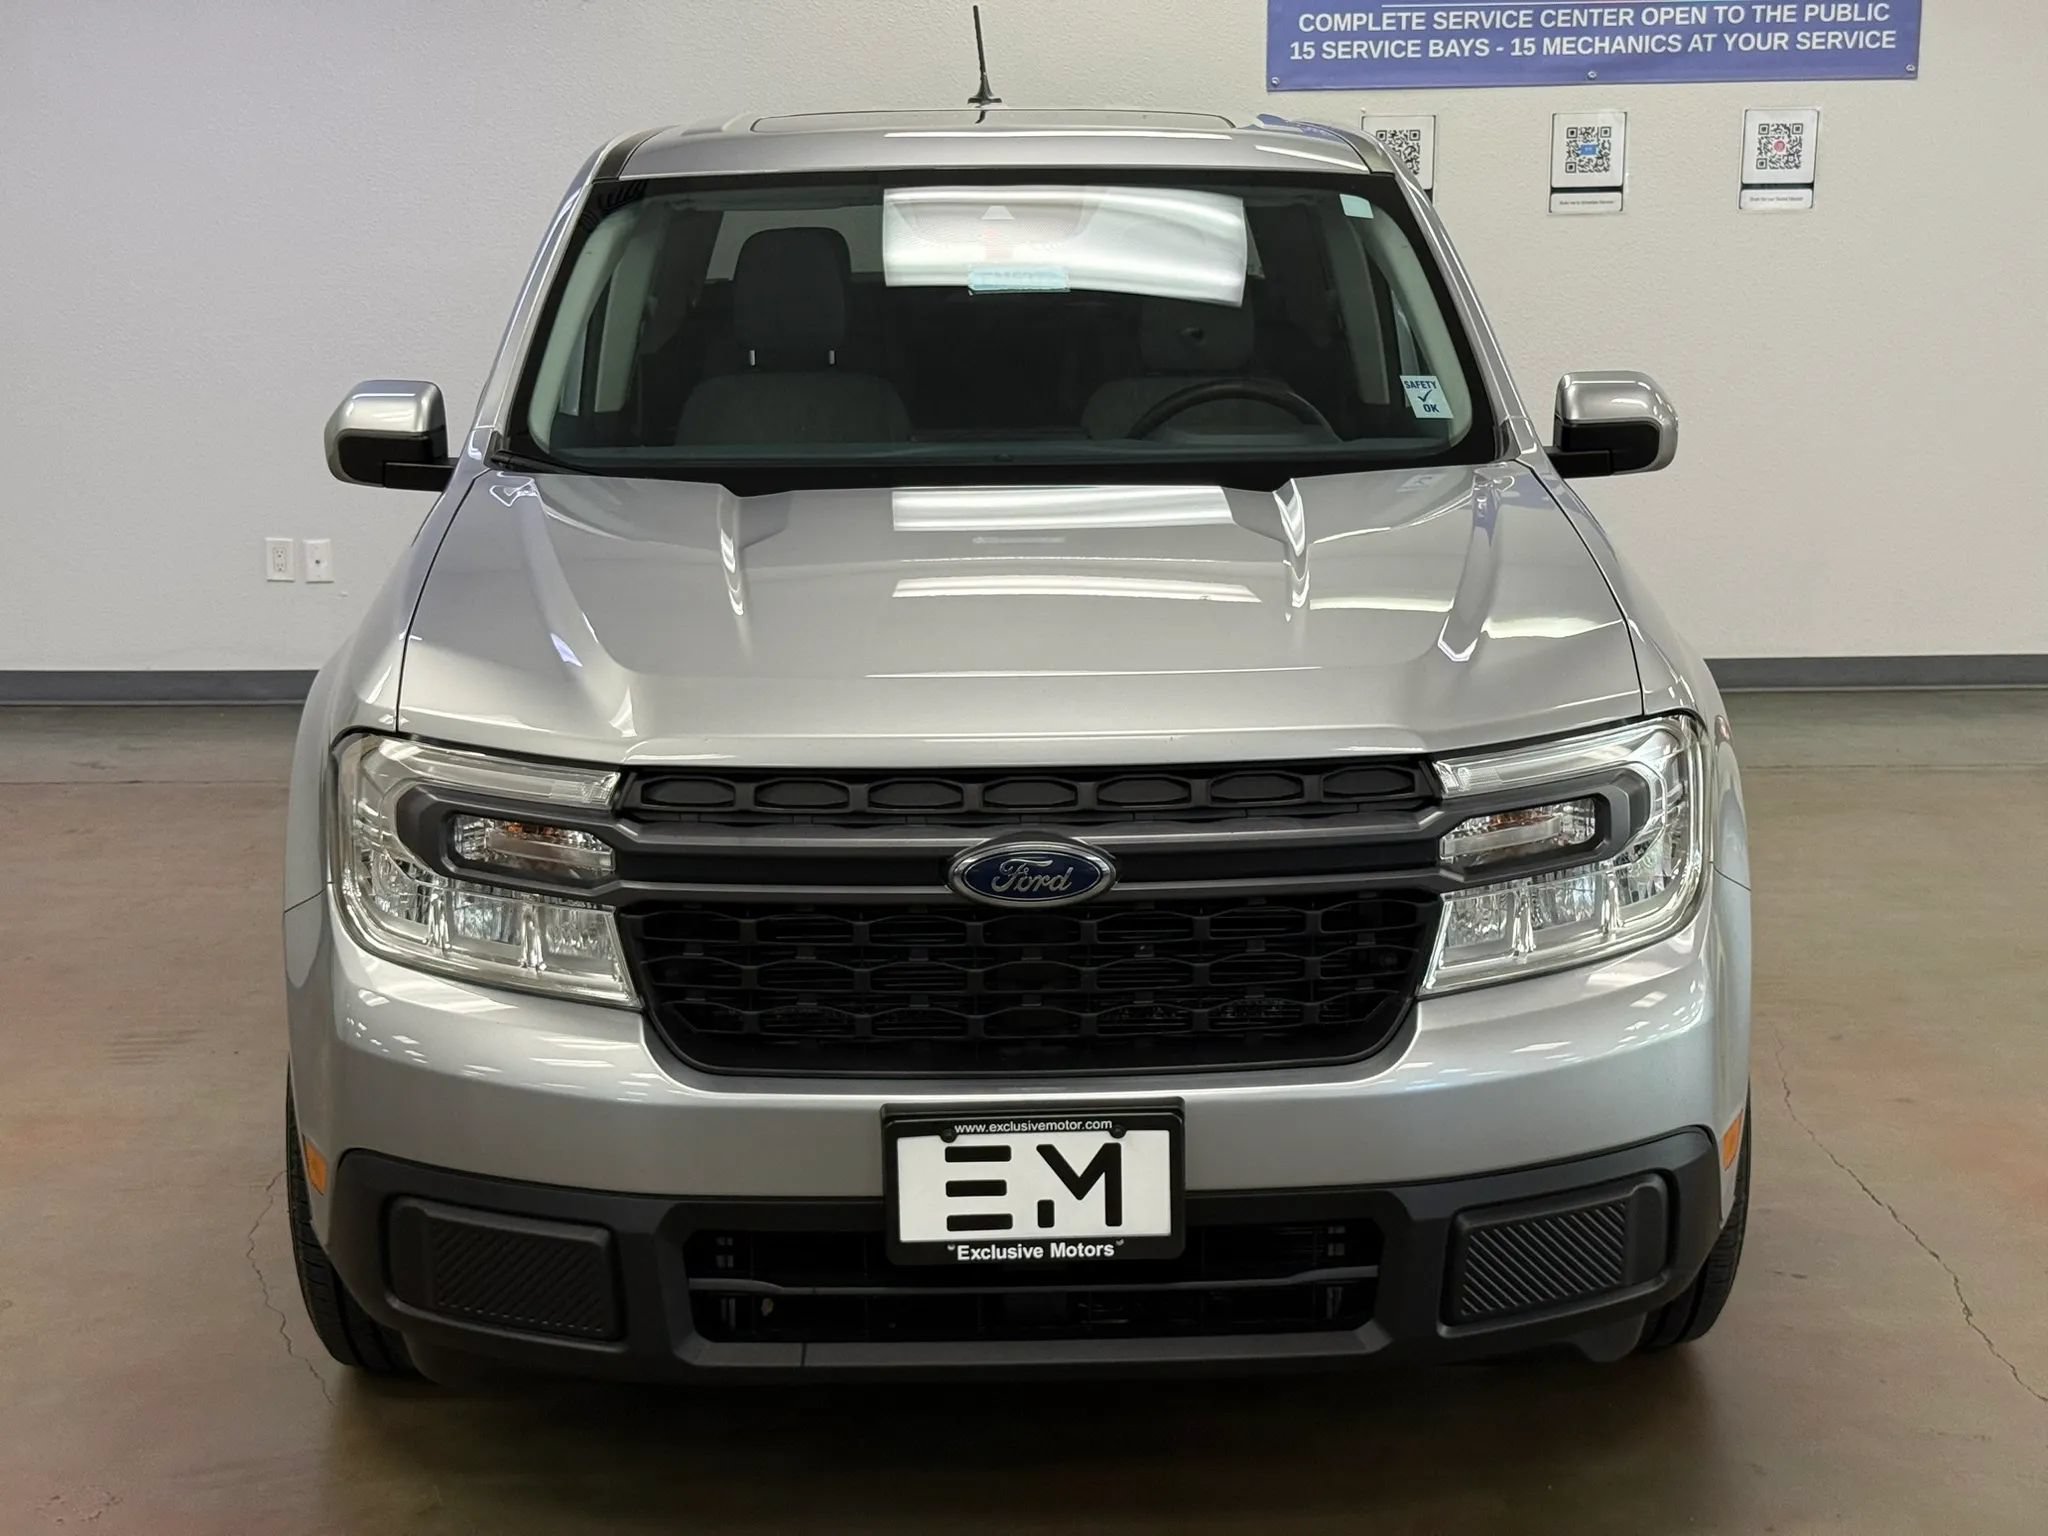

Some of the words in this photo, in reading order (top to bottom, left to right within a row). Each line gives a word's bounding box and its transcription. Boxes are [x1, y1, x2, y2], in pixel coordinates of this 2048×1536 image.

[1298, 11, 1427, 33] COMPLETE
[1432, 9, 1534, 31] SERVICE
[1539, 7, 1635, 29] CENTER
[1641, 5, 1708, 27] OPEN
[1713, 5, 1746, 25] TO
[1751, 4, 1798, 24] THE
[1803, 2, 1891, 24] PUBLIC
[1289, 41, 1316, 60] 15
[1321, 39, 1423, 60] SERVICE
[1428, 37, 1491, 58] BAYS
[1510, 37, 1536, 57] 15
[1542, 34, 1683, 57] MECHANICS
[1687, 33, 1717, 53] AT
[1722, 31, 1790, 53] YOUR
[1795, 29, 1897, 51] SERVICE
[1403, 380, 1438, 390] SAFETY
[1423, 403, 1441, 414] OK
[990, 856, 1075, 893] Ford
[954, 1118, 1114, 1135] www.exclusivemotor.com
[956, 1242, 1045, 1262] Exclusive
[1049, 1241, 1116, 1259] Motors
